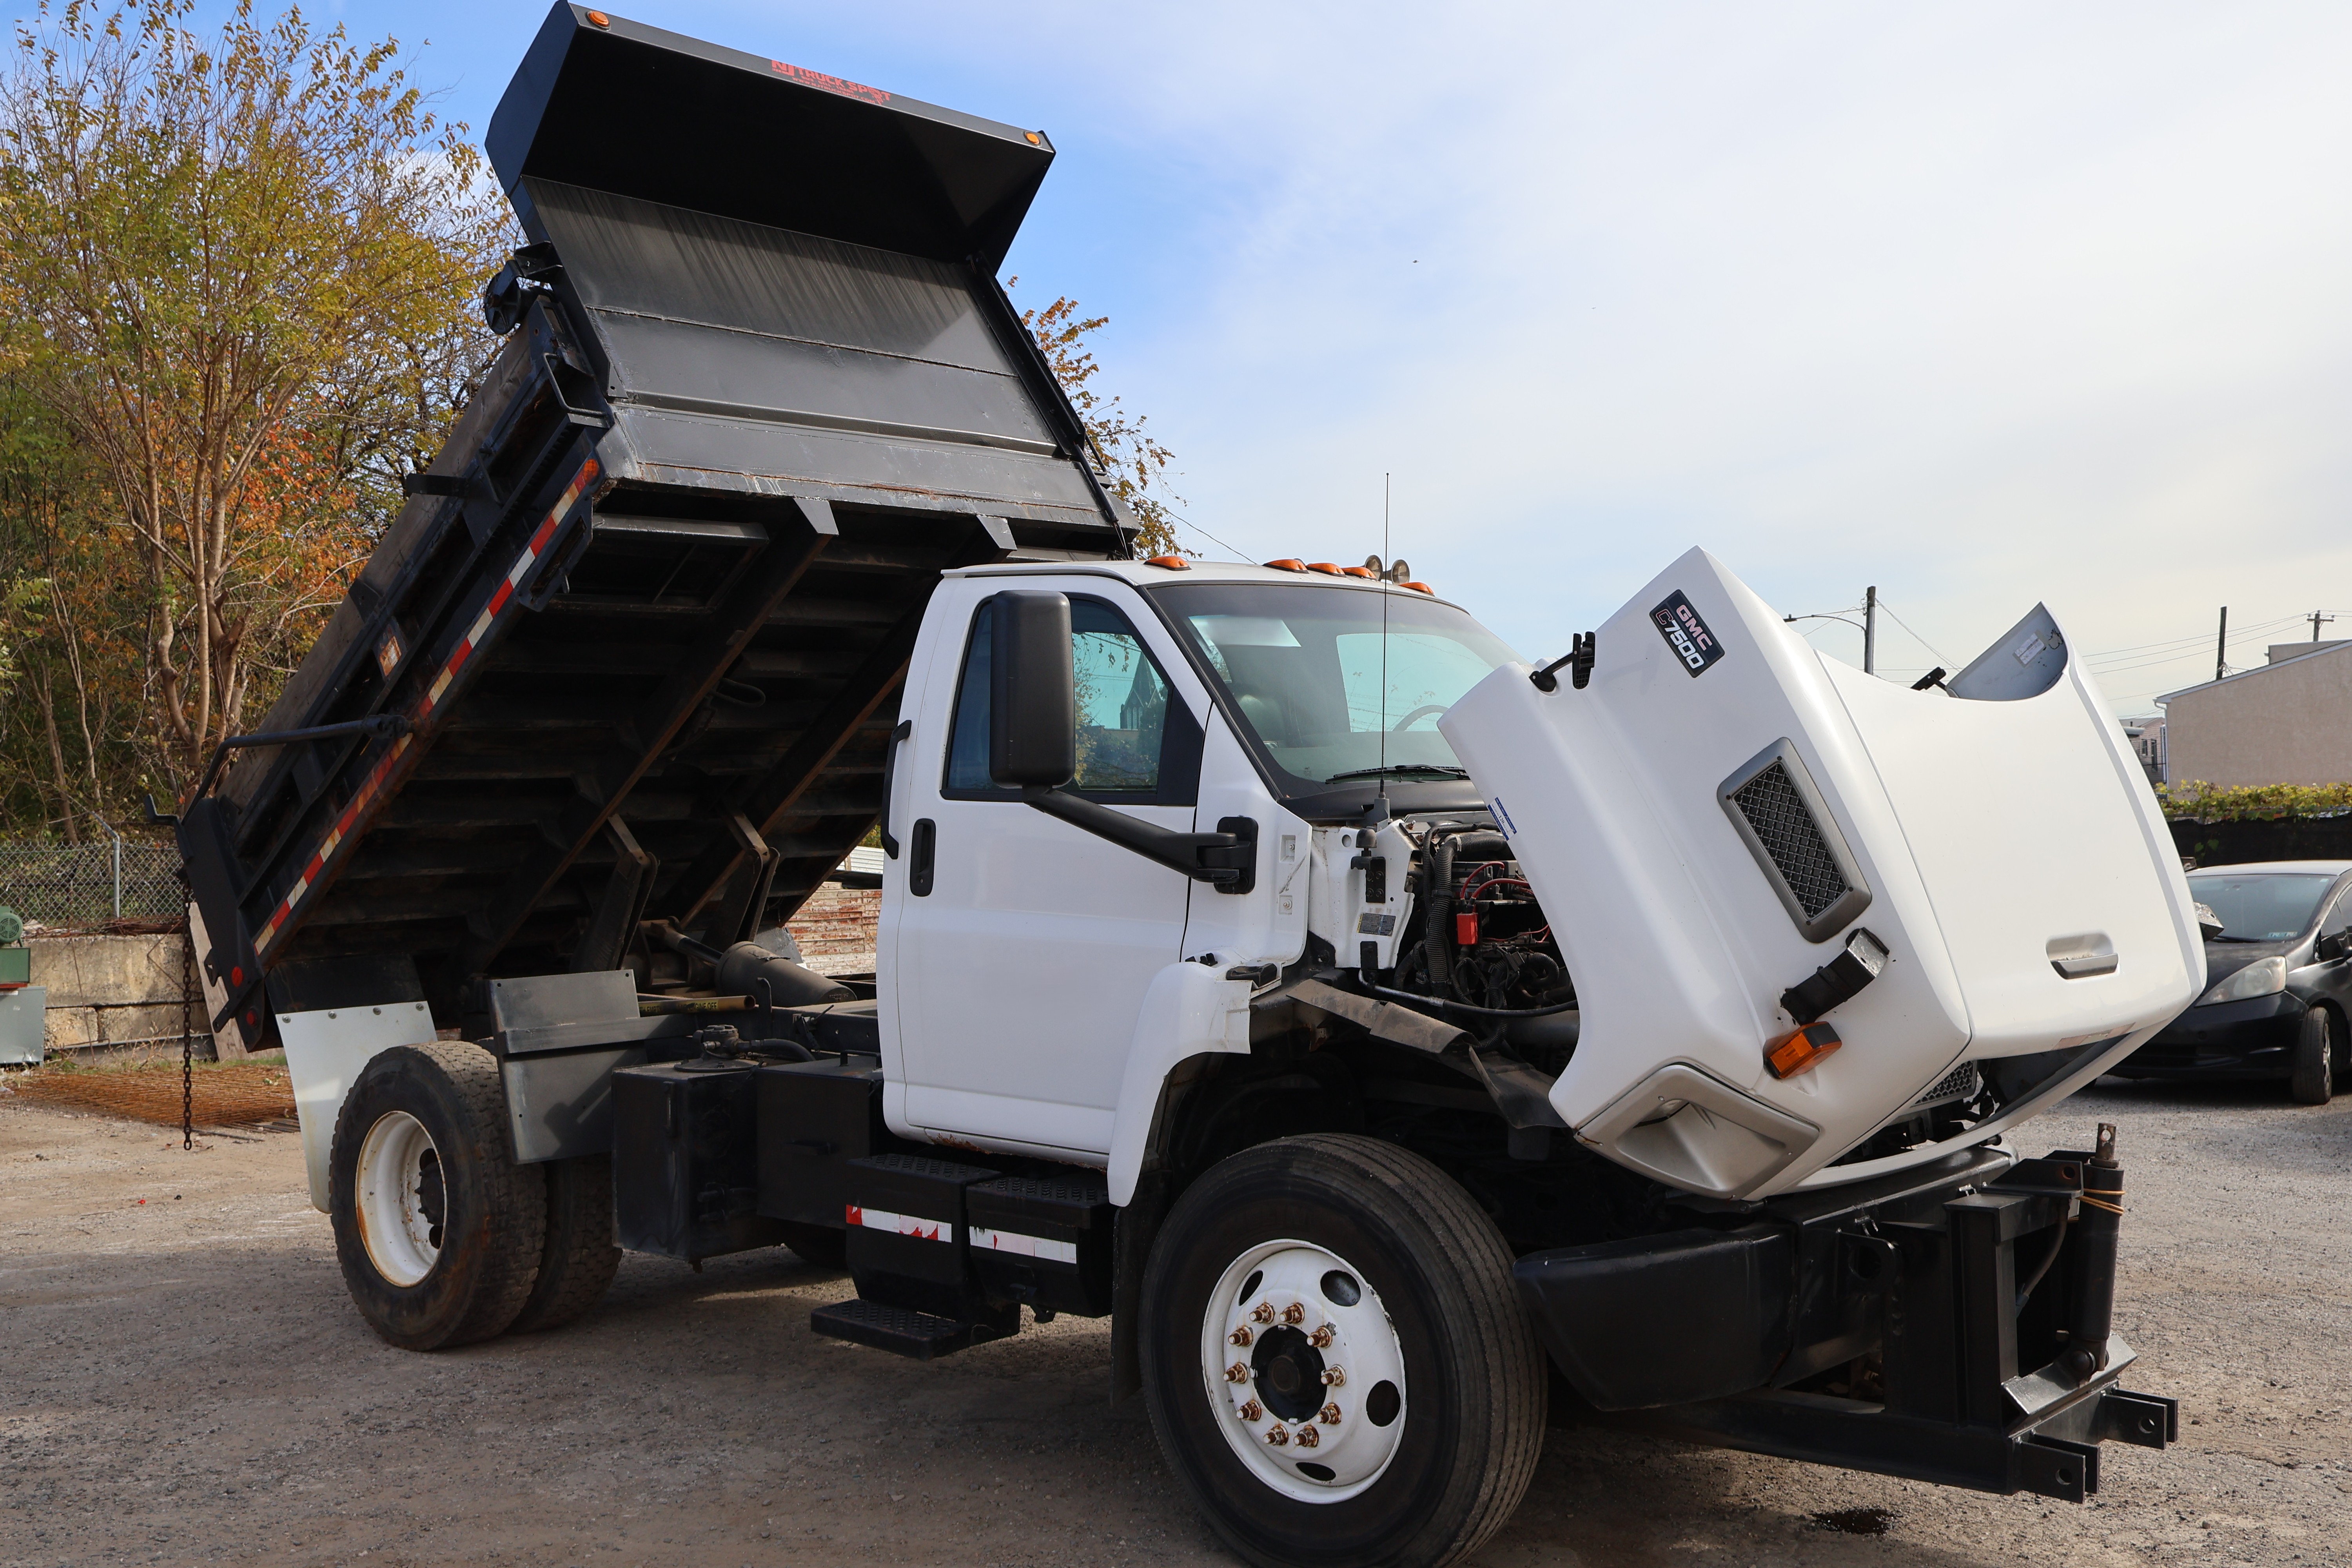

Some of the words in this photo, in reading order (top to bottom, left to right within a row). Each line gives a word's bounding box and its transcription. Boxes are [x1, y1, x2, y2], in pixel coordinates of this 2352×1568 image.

[771, 60, 795, 76] NJ
[795, 66, 845, 88] TRUCK
[1655, 609, 1704, 669] C7500
[1676, 604, 1713, 651] GMC
[707, 1002, 717, 1010] OFF
